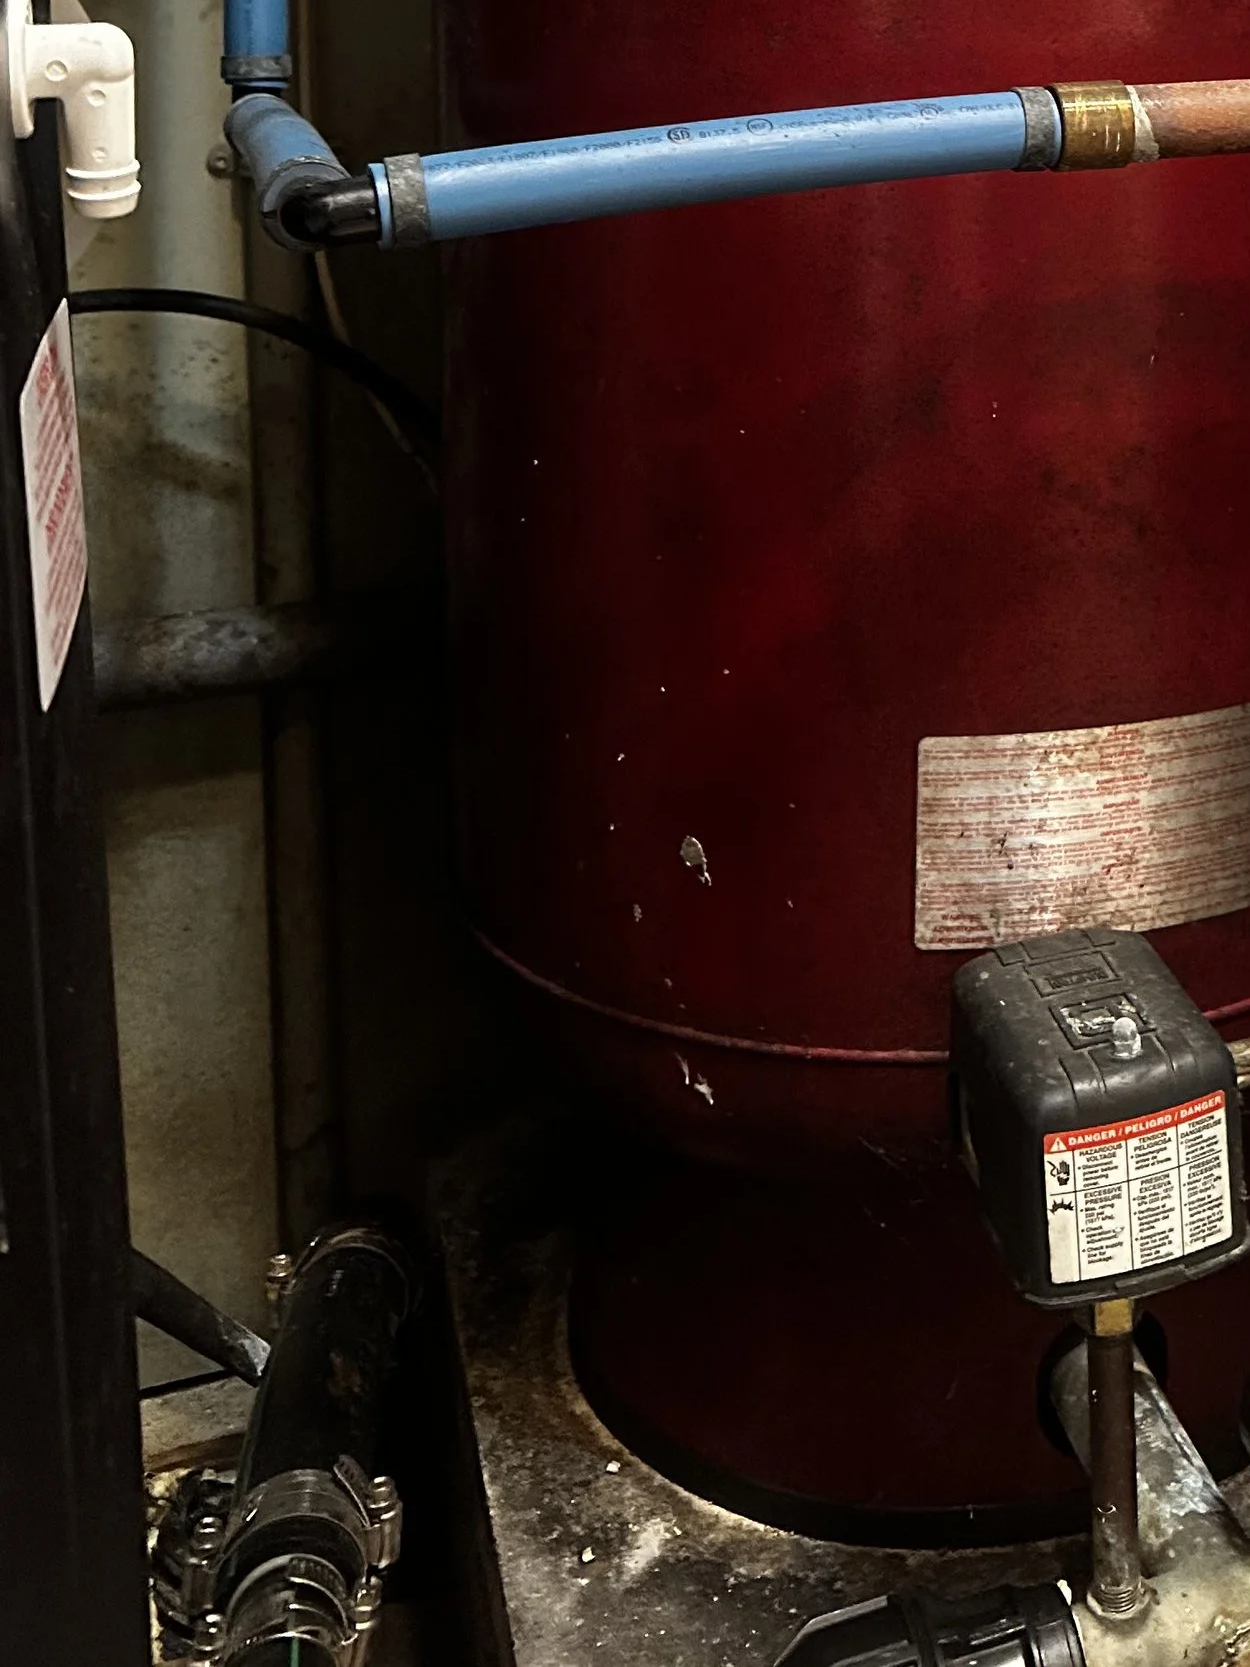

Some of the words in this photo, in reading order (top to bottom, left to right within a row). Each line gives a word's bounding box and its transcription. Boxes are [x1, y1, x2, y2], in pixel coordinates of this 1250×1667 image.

[1068, 1129, 1117, 1146] DANGER
[1124, 1114, 1172, 1135] PELIGRO
[1180, 1095, 1221, 1119] DANGER
[1079, 1143, 1123, 1156] HAZARDOUS
[1134, 1137, 1172, 1152] PELIGROSA
[1086, 1151, 1116, 1162] VOLTAGE
[1084, 1185, 1122, 1198] EXCESSIVE
[1085, 1193, 1122, 1205] PRESSURE
